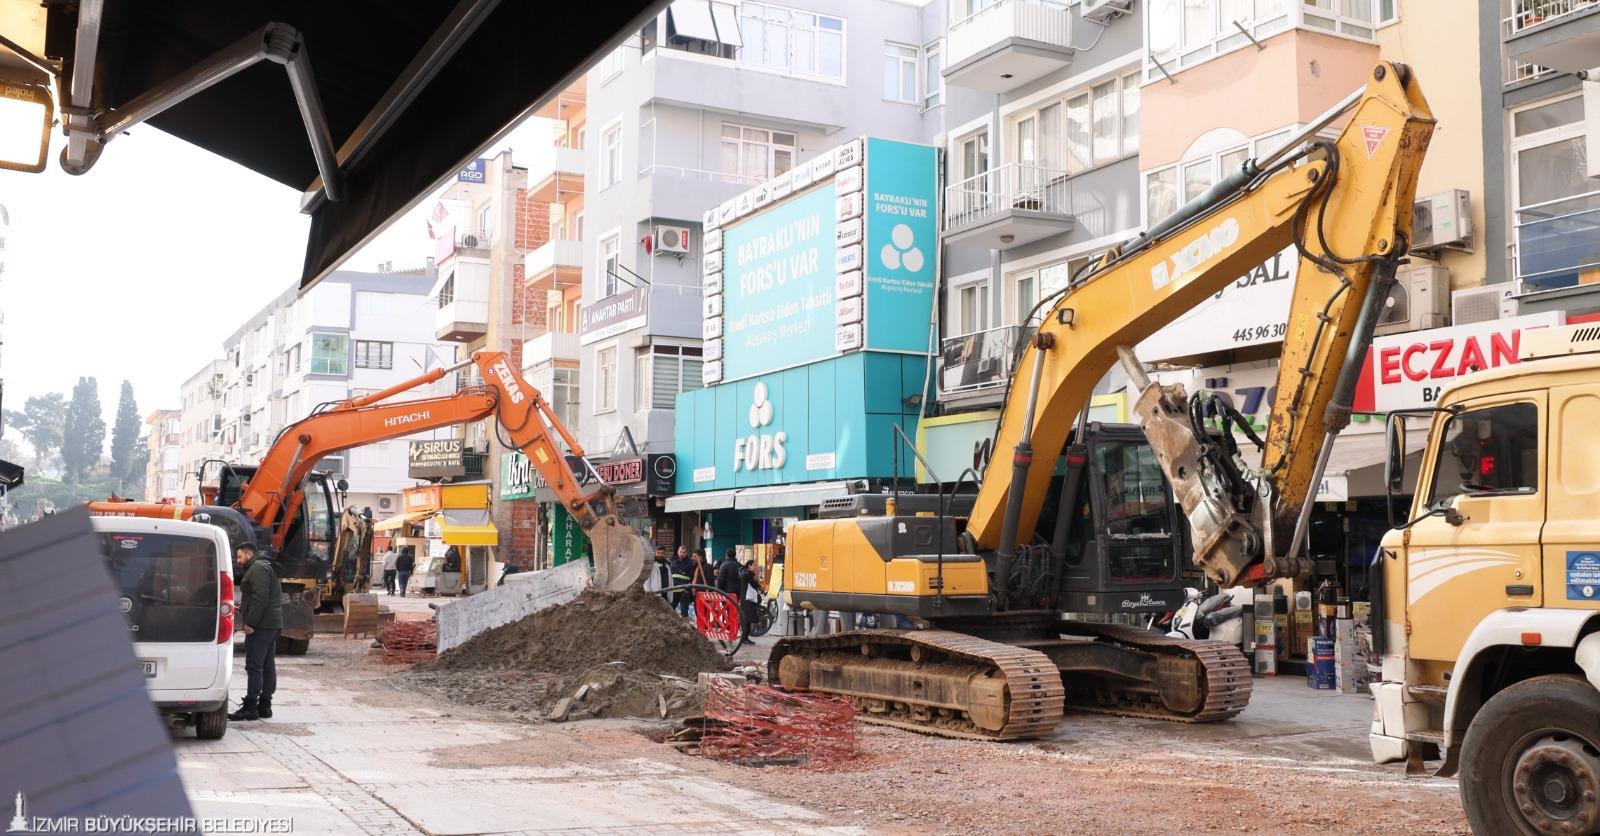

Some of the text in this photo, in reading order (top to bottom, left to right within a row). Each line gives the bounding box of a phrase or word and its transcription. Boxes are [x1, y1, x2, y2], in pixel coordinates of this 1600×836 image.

[875, 203, 927, 218] FORS'U VAR
[737, 213, 821, 267] BAYRAKLI'NIN
[739, 247, 819, 298] FORS'U VAR
[591, 304, 617, 325] ANAHTAR
[1232, 322, 1287, 342] 445 96 30
[1380, 326, 1549, 385] ECZAN
[384, 410, 430, 427] HITACHI
[733, 431, 787, 472] FORS
